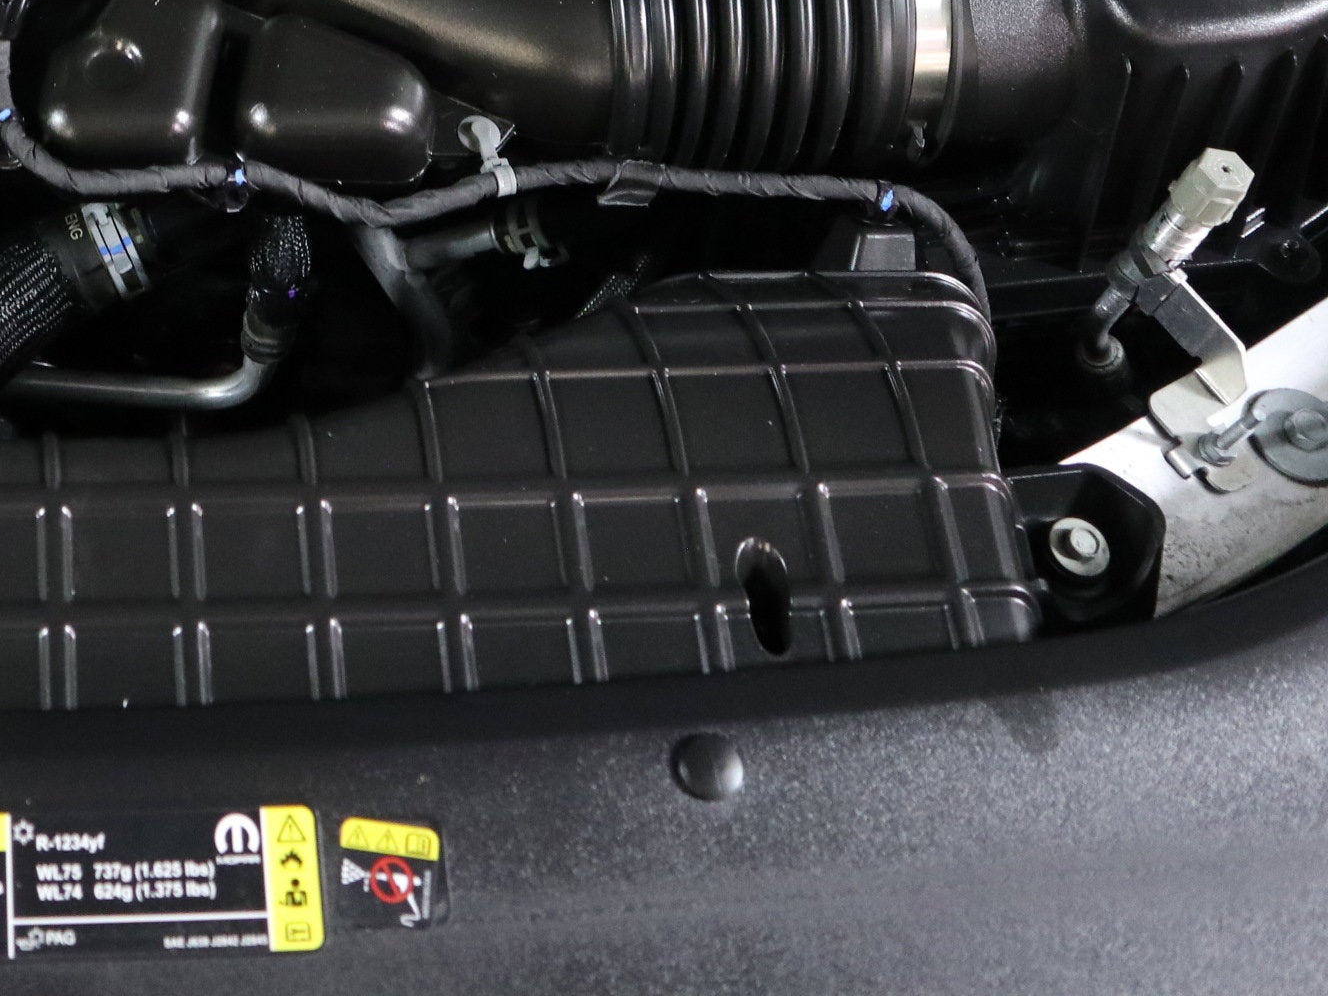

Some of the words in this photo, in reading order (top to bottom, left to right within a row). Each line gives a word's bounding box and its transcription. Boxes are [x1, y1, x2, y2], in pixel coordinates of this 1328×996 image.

[65, 212, 83, 241] ENG
[35, 832, 105, 853] R-1234yf
[35, 863, 83, 882] WL75
[92, 861, 133, 883] 737g
[135, 860, 182, 883] (1.625
[184, 859, 216, 880] lbs)
[36, 883, 84, 902] WL74
[93, 882, 133, 903] 624g
[135, 880, 183, 903] (1.375
[185, 879, 217, 900] lbs)
[45, 929, 77, 946] PAG
